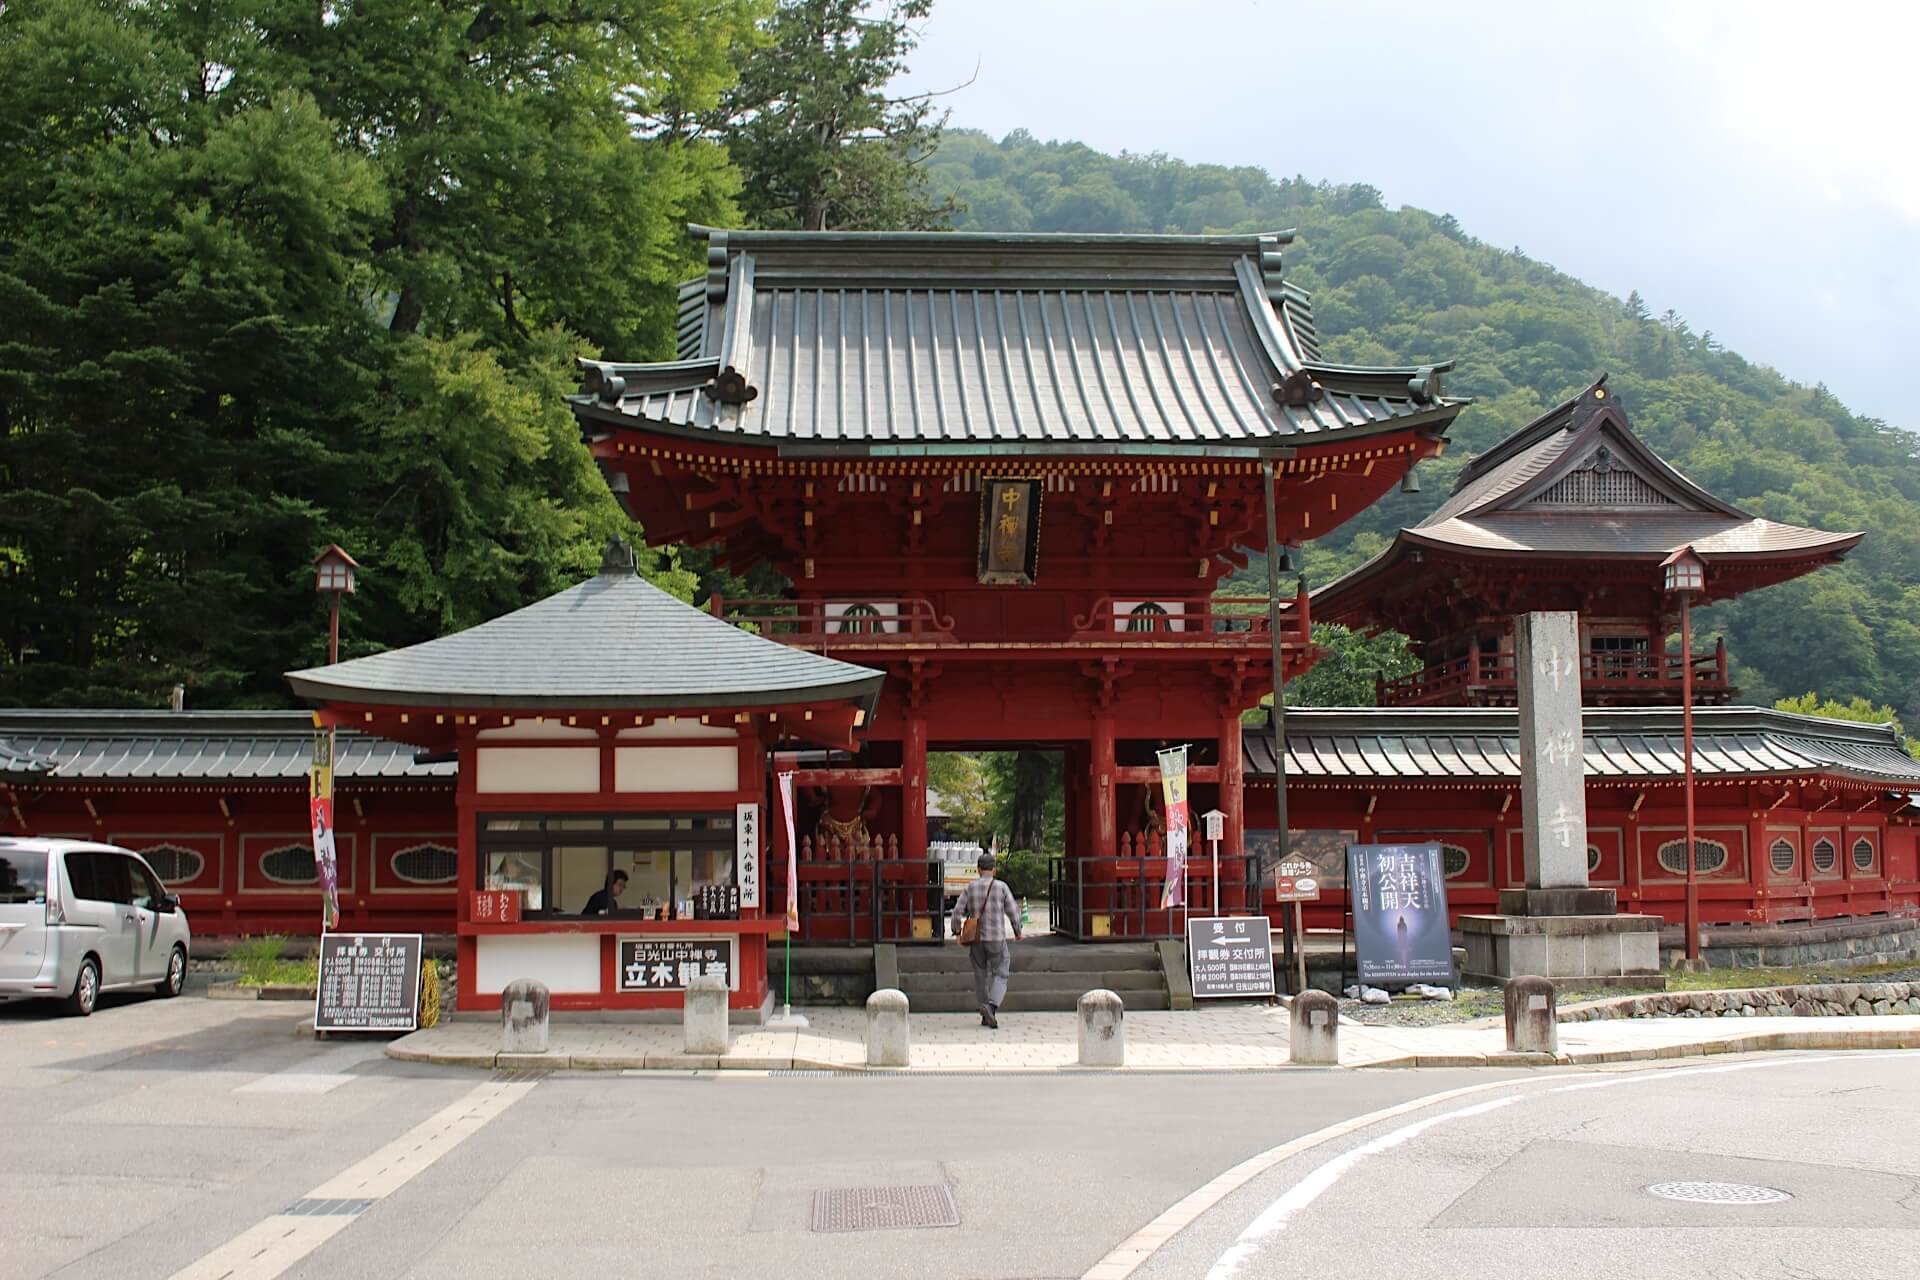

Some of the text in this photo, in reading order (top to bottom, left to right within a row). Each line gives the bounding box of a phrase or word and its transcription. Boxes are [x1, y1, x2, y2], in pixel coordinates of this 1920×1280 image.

[743, 810, 754, 901] 坂東十八番札所
[1377, 854, 1399, 910] 初公開
[1398, 853, 1420, 909] 吉祥天
[625, 961, 728, 987] 立木観音
[634, 949, 718, 961] 日光山中禅寺
[1232, 947, 1265, 960] 交付所
